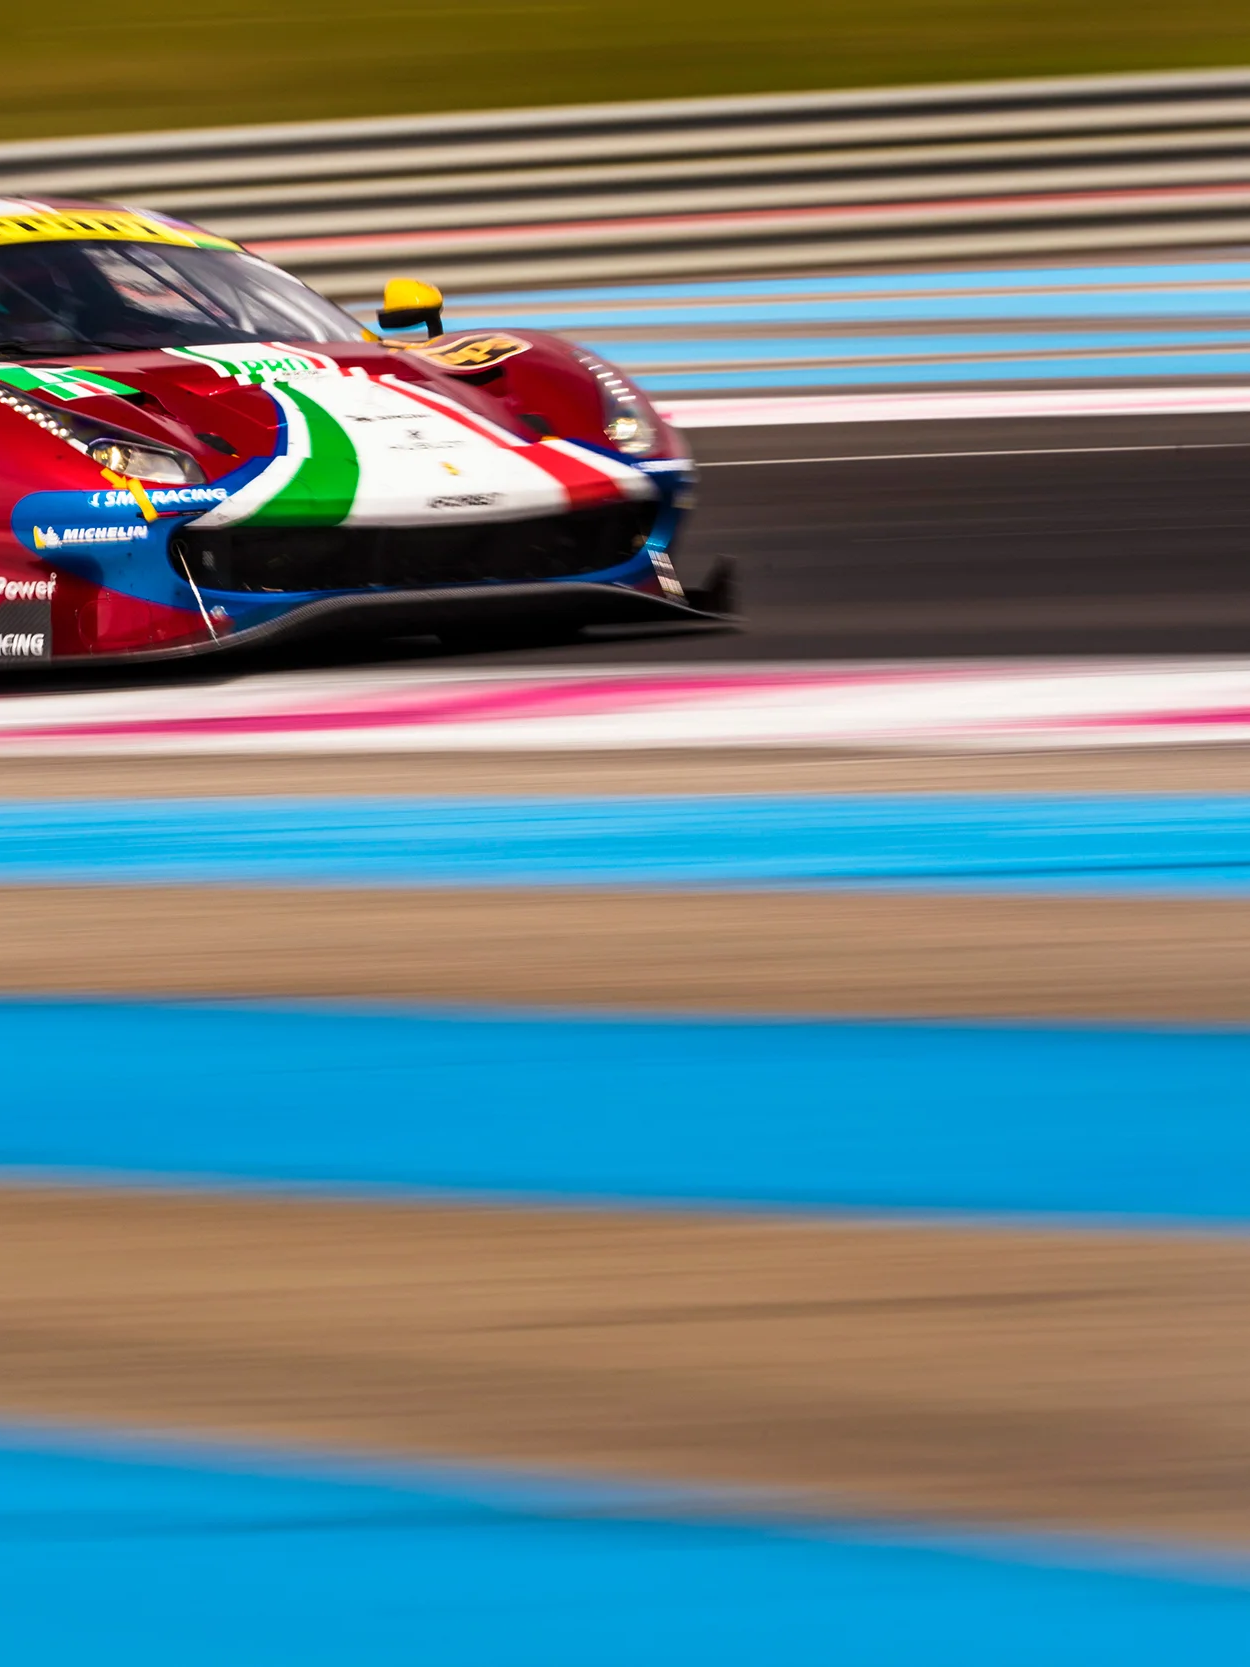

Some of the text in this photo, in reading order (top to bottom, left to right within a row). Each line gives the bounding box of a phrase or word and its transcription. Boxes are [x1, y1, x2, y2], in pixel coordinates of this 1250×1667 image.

[104, 488, 228, 507] SM RACING
[63, 525, 149, 540] MICHELIN
